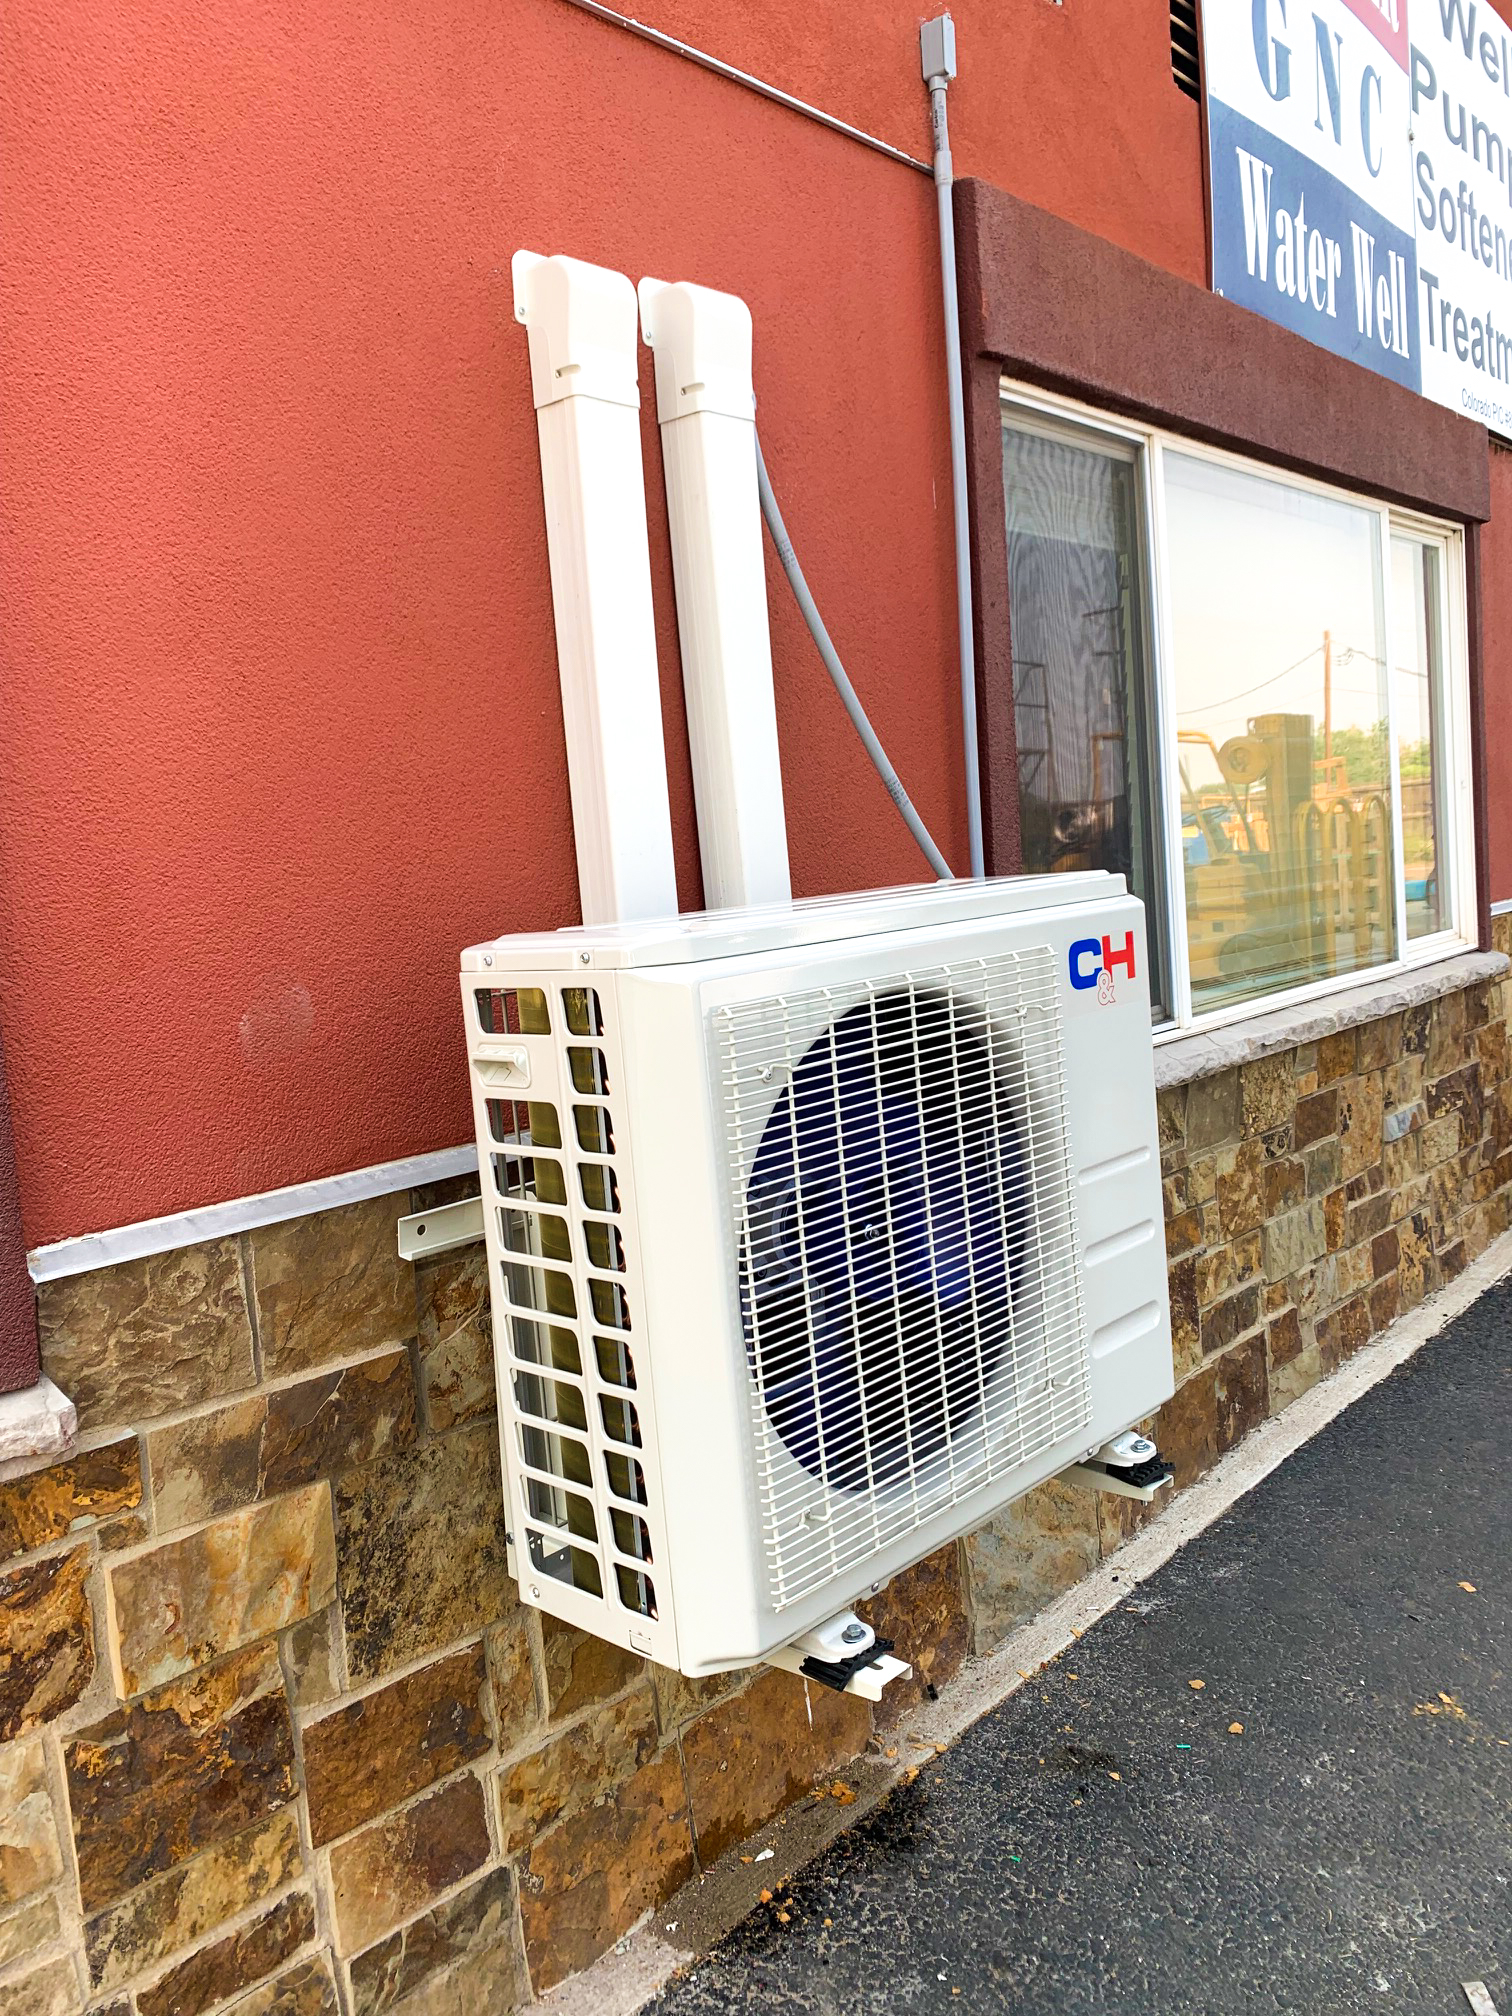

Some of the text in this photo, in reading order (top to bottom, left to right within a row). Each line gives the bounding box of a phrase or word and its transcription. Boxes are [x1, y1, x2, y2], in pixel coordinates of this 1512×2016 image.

[1251, 0, 1382, 178] GNC
[1438, 0, 1512, 98] Wel
[1235, 145, 1410, 360] Water Well
[1461, 387, 1492, 419] Colorado
